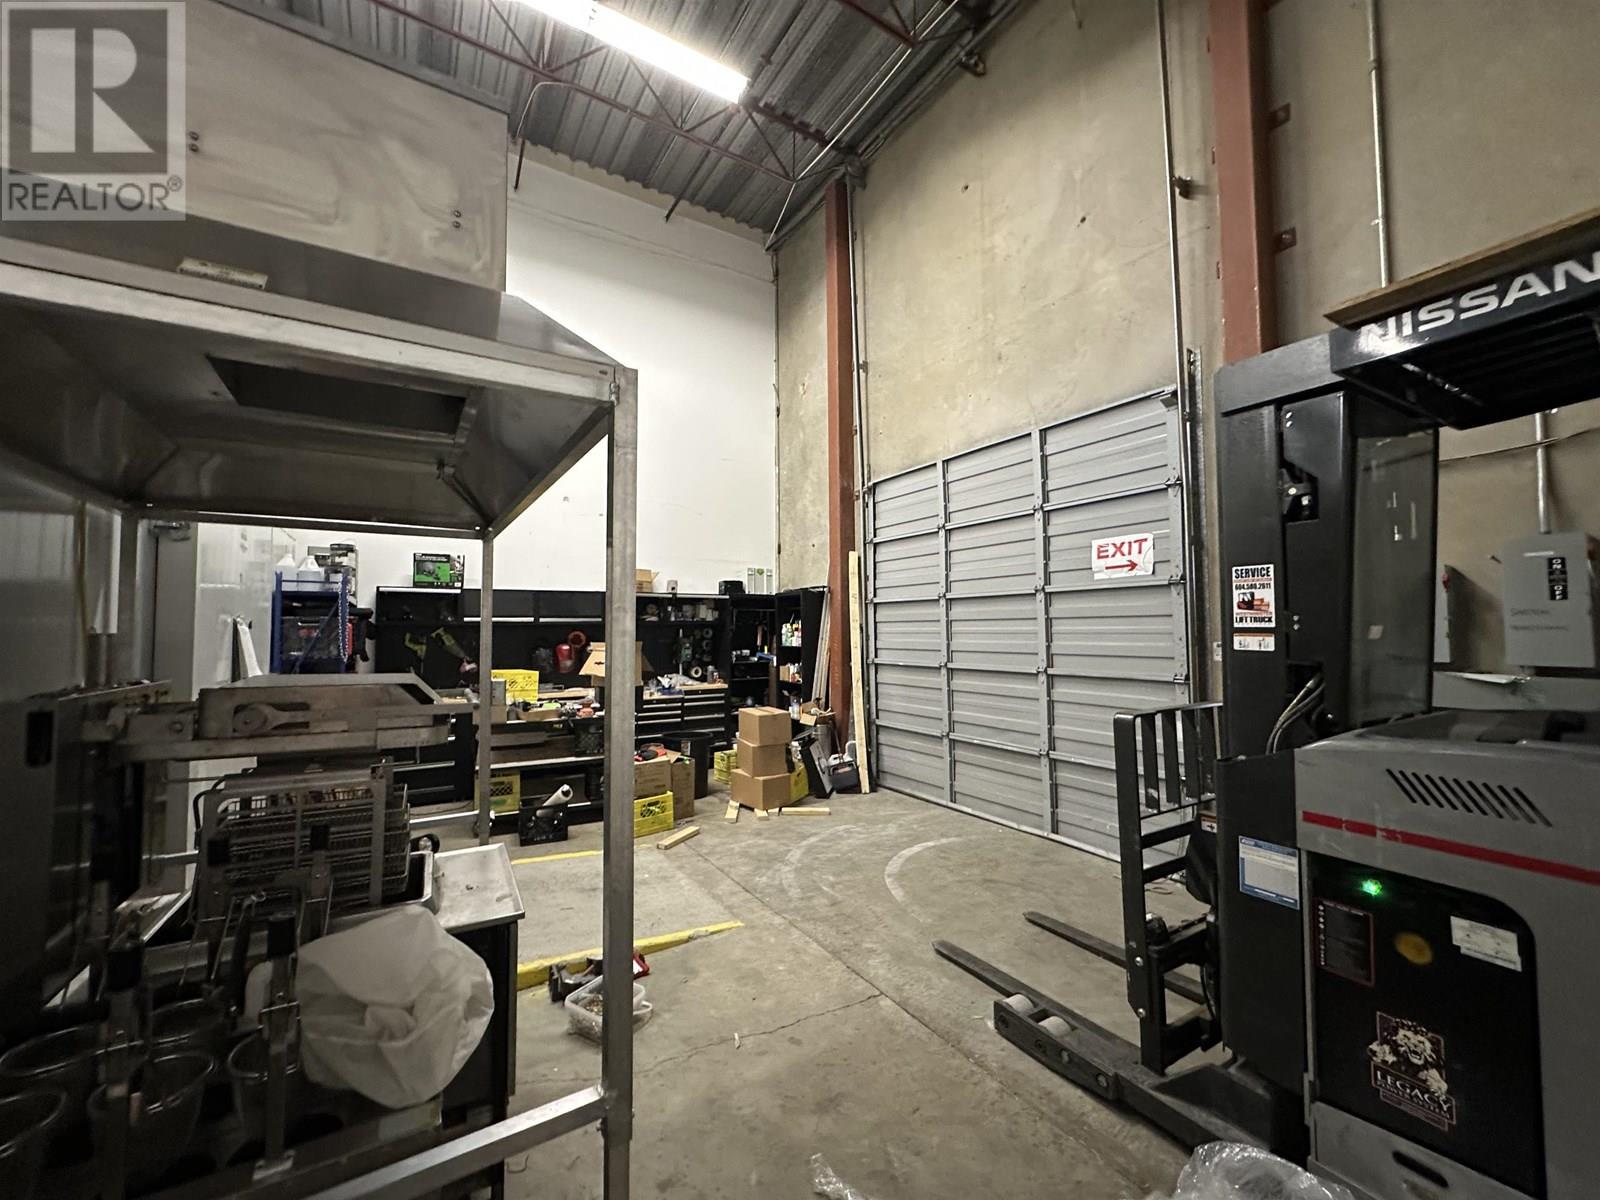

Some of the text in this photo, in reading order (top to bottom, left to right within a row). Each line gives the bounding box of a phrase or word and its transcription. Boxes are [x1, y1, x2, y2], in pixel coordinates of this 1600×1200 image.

[1358, 251, 1600, 345] NISSAN
[1096, 538, 1148, 560] EXIT
[1234, 566, 1271, 579] SERVICE
